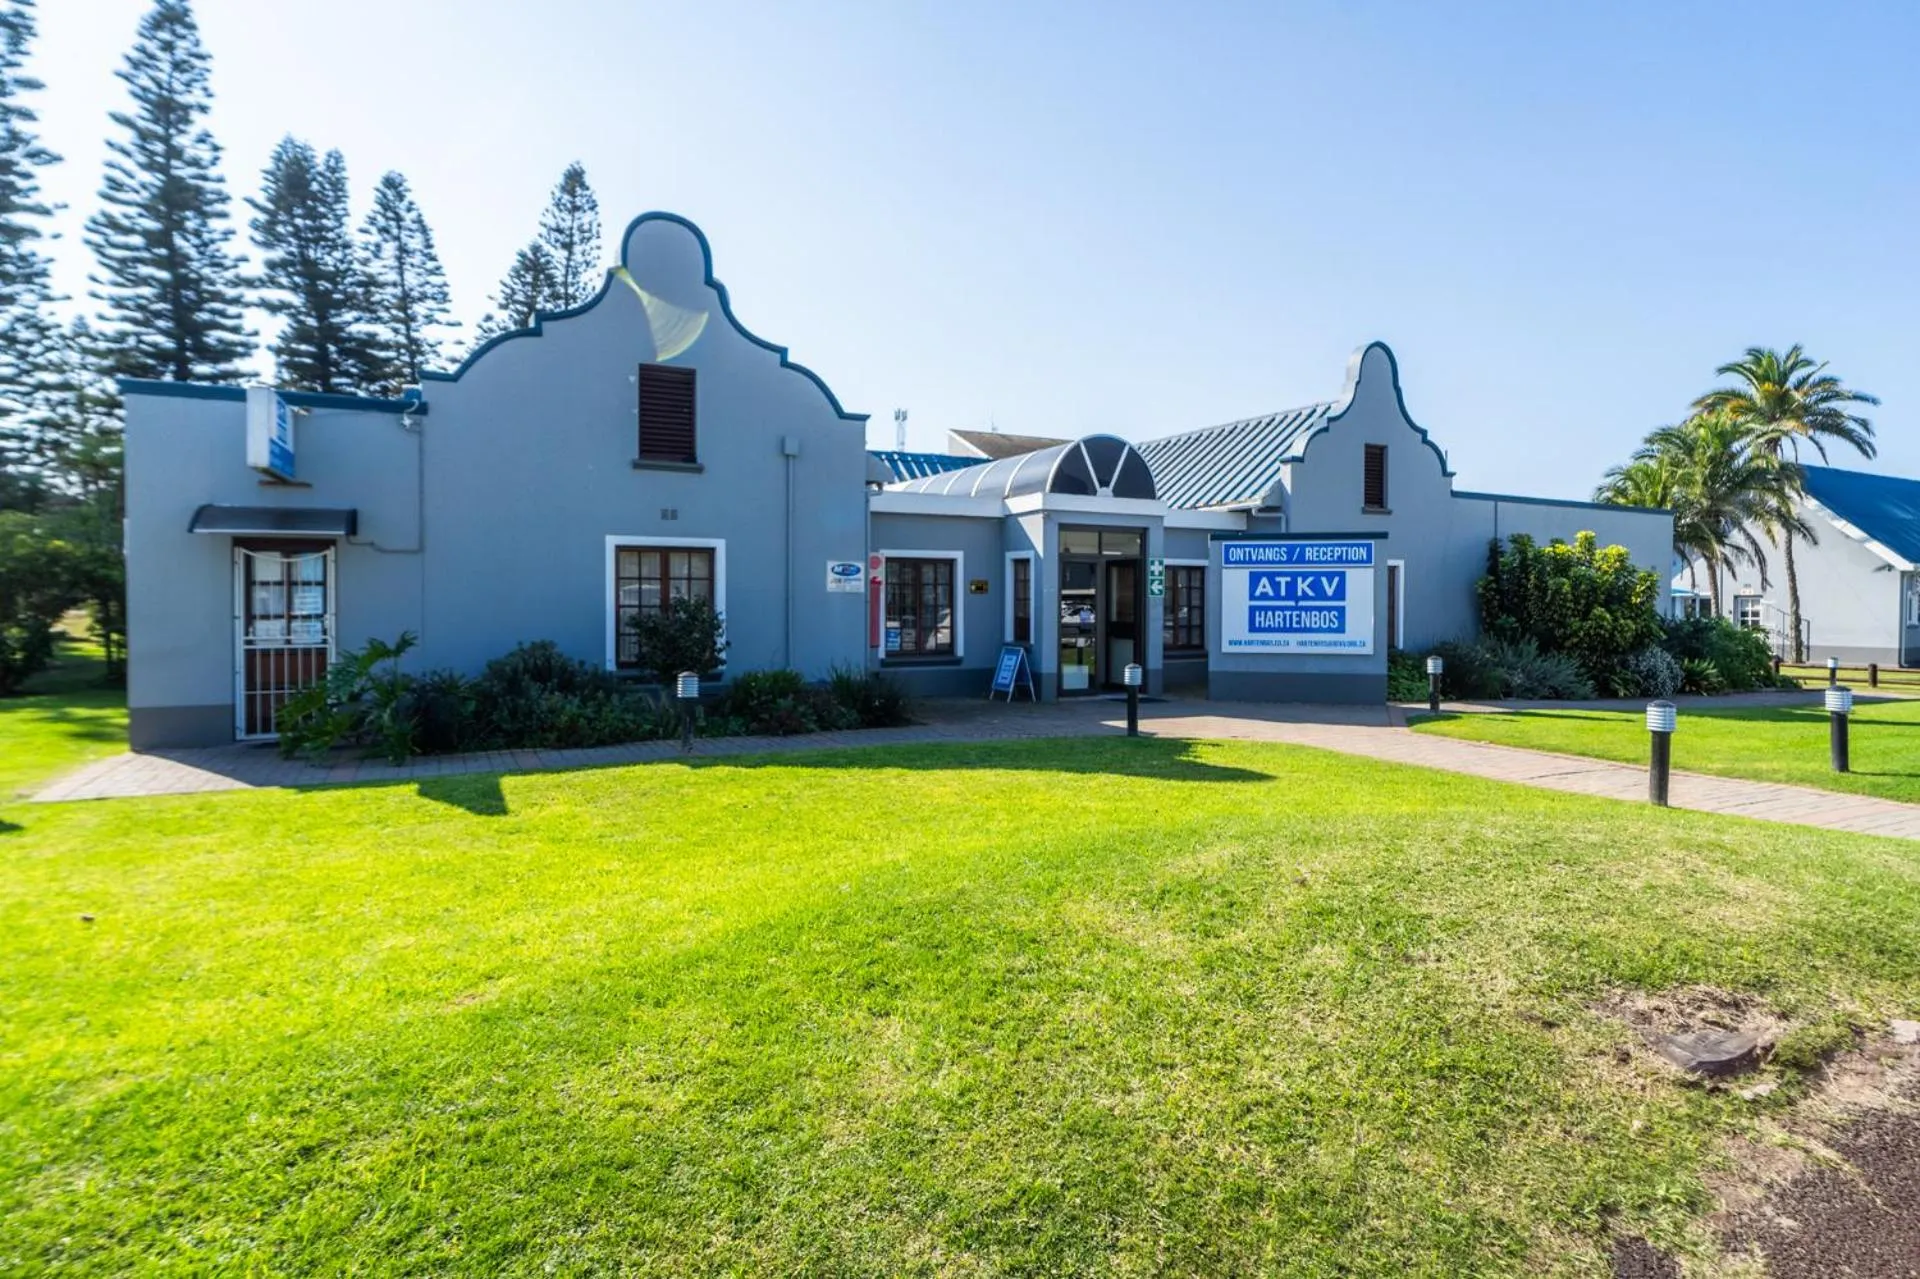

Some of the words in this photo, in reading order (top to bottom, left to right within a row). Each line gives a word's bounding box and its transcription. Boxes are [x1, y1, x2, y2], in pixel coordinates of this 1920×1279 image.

[1229, 547, 1287, 561] ONTVANGS
[1292, 548, 1300, 561] /
[1305, 546, 1367, 561] RECEPTION
[1254, 576, 1339, 596] ATKV
[1255, 610, 1338, 628] HARTENBOS
